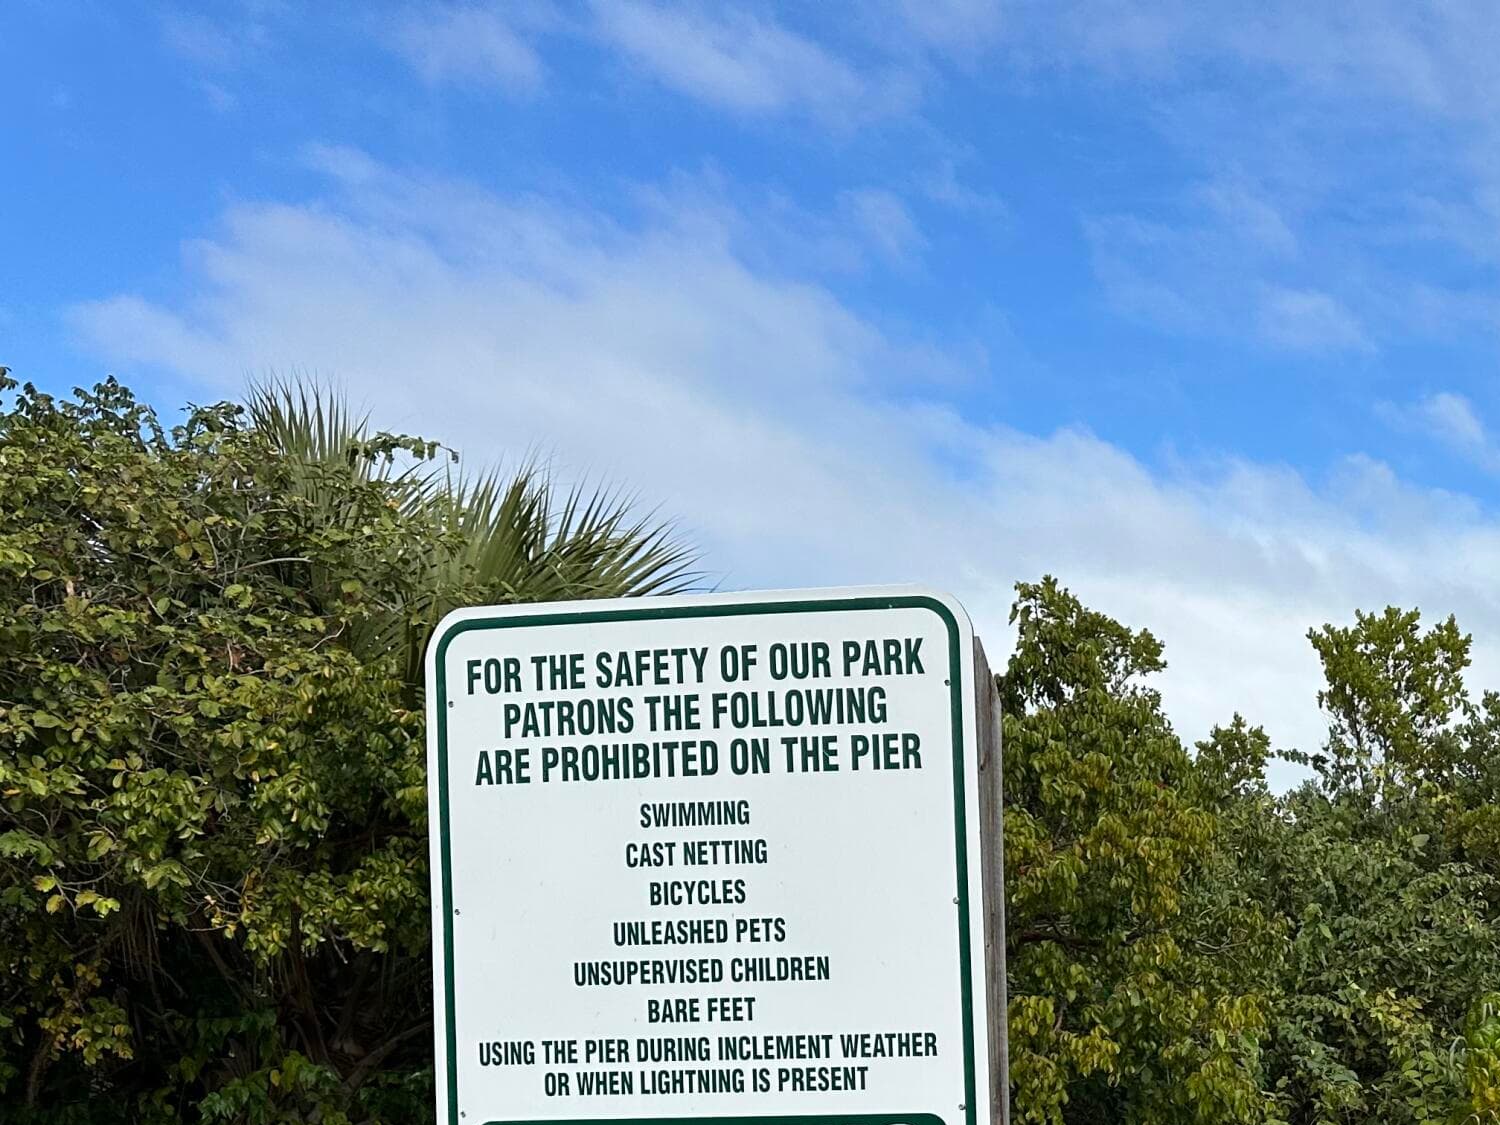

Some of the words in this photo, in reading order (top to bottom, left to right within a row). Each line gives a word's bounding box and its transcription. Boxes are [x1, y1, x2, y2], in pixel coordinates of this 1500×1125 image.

[466, 656, 522, 696] FOR
[530, 652, 586, 691] THE
[595, 645, 709, 688] SAFETY
[719, 643, 758, 682] OF
[768, 641, 832, 681] OUR
[842, 636, 926, 677] PARK
[503, 695, 634, 739] PATRONS
[643, 693, 701, 732] THE
[711, 685, 888, 729] FOLLOWING
[475, 747, 532, 786] ARE
[541, 739, 719, 782] PROHIBITED
[730, 736, 771, 776] ON
[780, 734, 840, 773] THE
[850, 731, 923, 771] PIER
[639, 798, 750, 828] SWIMMING
[625, 841, 676, 868] CAST
[682, 838, 768, 866] NETTING
[649, 877, 747, 906] BICYCLES
[613, 918, 729, 946] UNLEASHED
[735, 917, 787, 943] PETS
[574, 957, 724, 986] UNSUPERVISED
[730, 955, 831, 983] CHILDREN
[647, 997, 700, 1023] BARE
[706, 996, 756, 1022] FEET
[478, 1039, 536, 1066] USING
[541, 1038, 579, 1065] THE
[585, 1037, 630, 1064] PIER
[636, 1035, 711, 1063] DURING
[717, 1033, 834, 1061] INCLEMENT
[839, 1031, 938, 1058] WEATHER
[544, 1071, 571, 1097] OR
[576, 1070, 634, 1096] WHEN
[640, 1067, 746, 1095] LIGHTNING
[752, 1067, 771, 1093] IS
[778, 1065, 870, 1092] PRESENT
